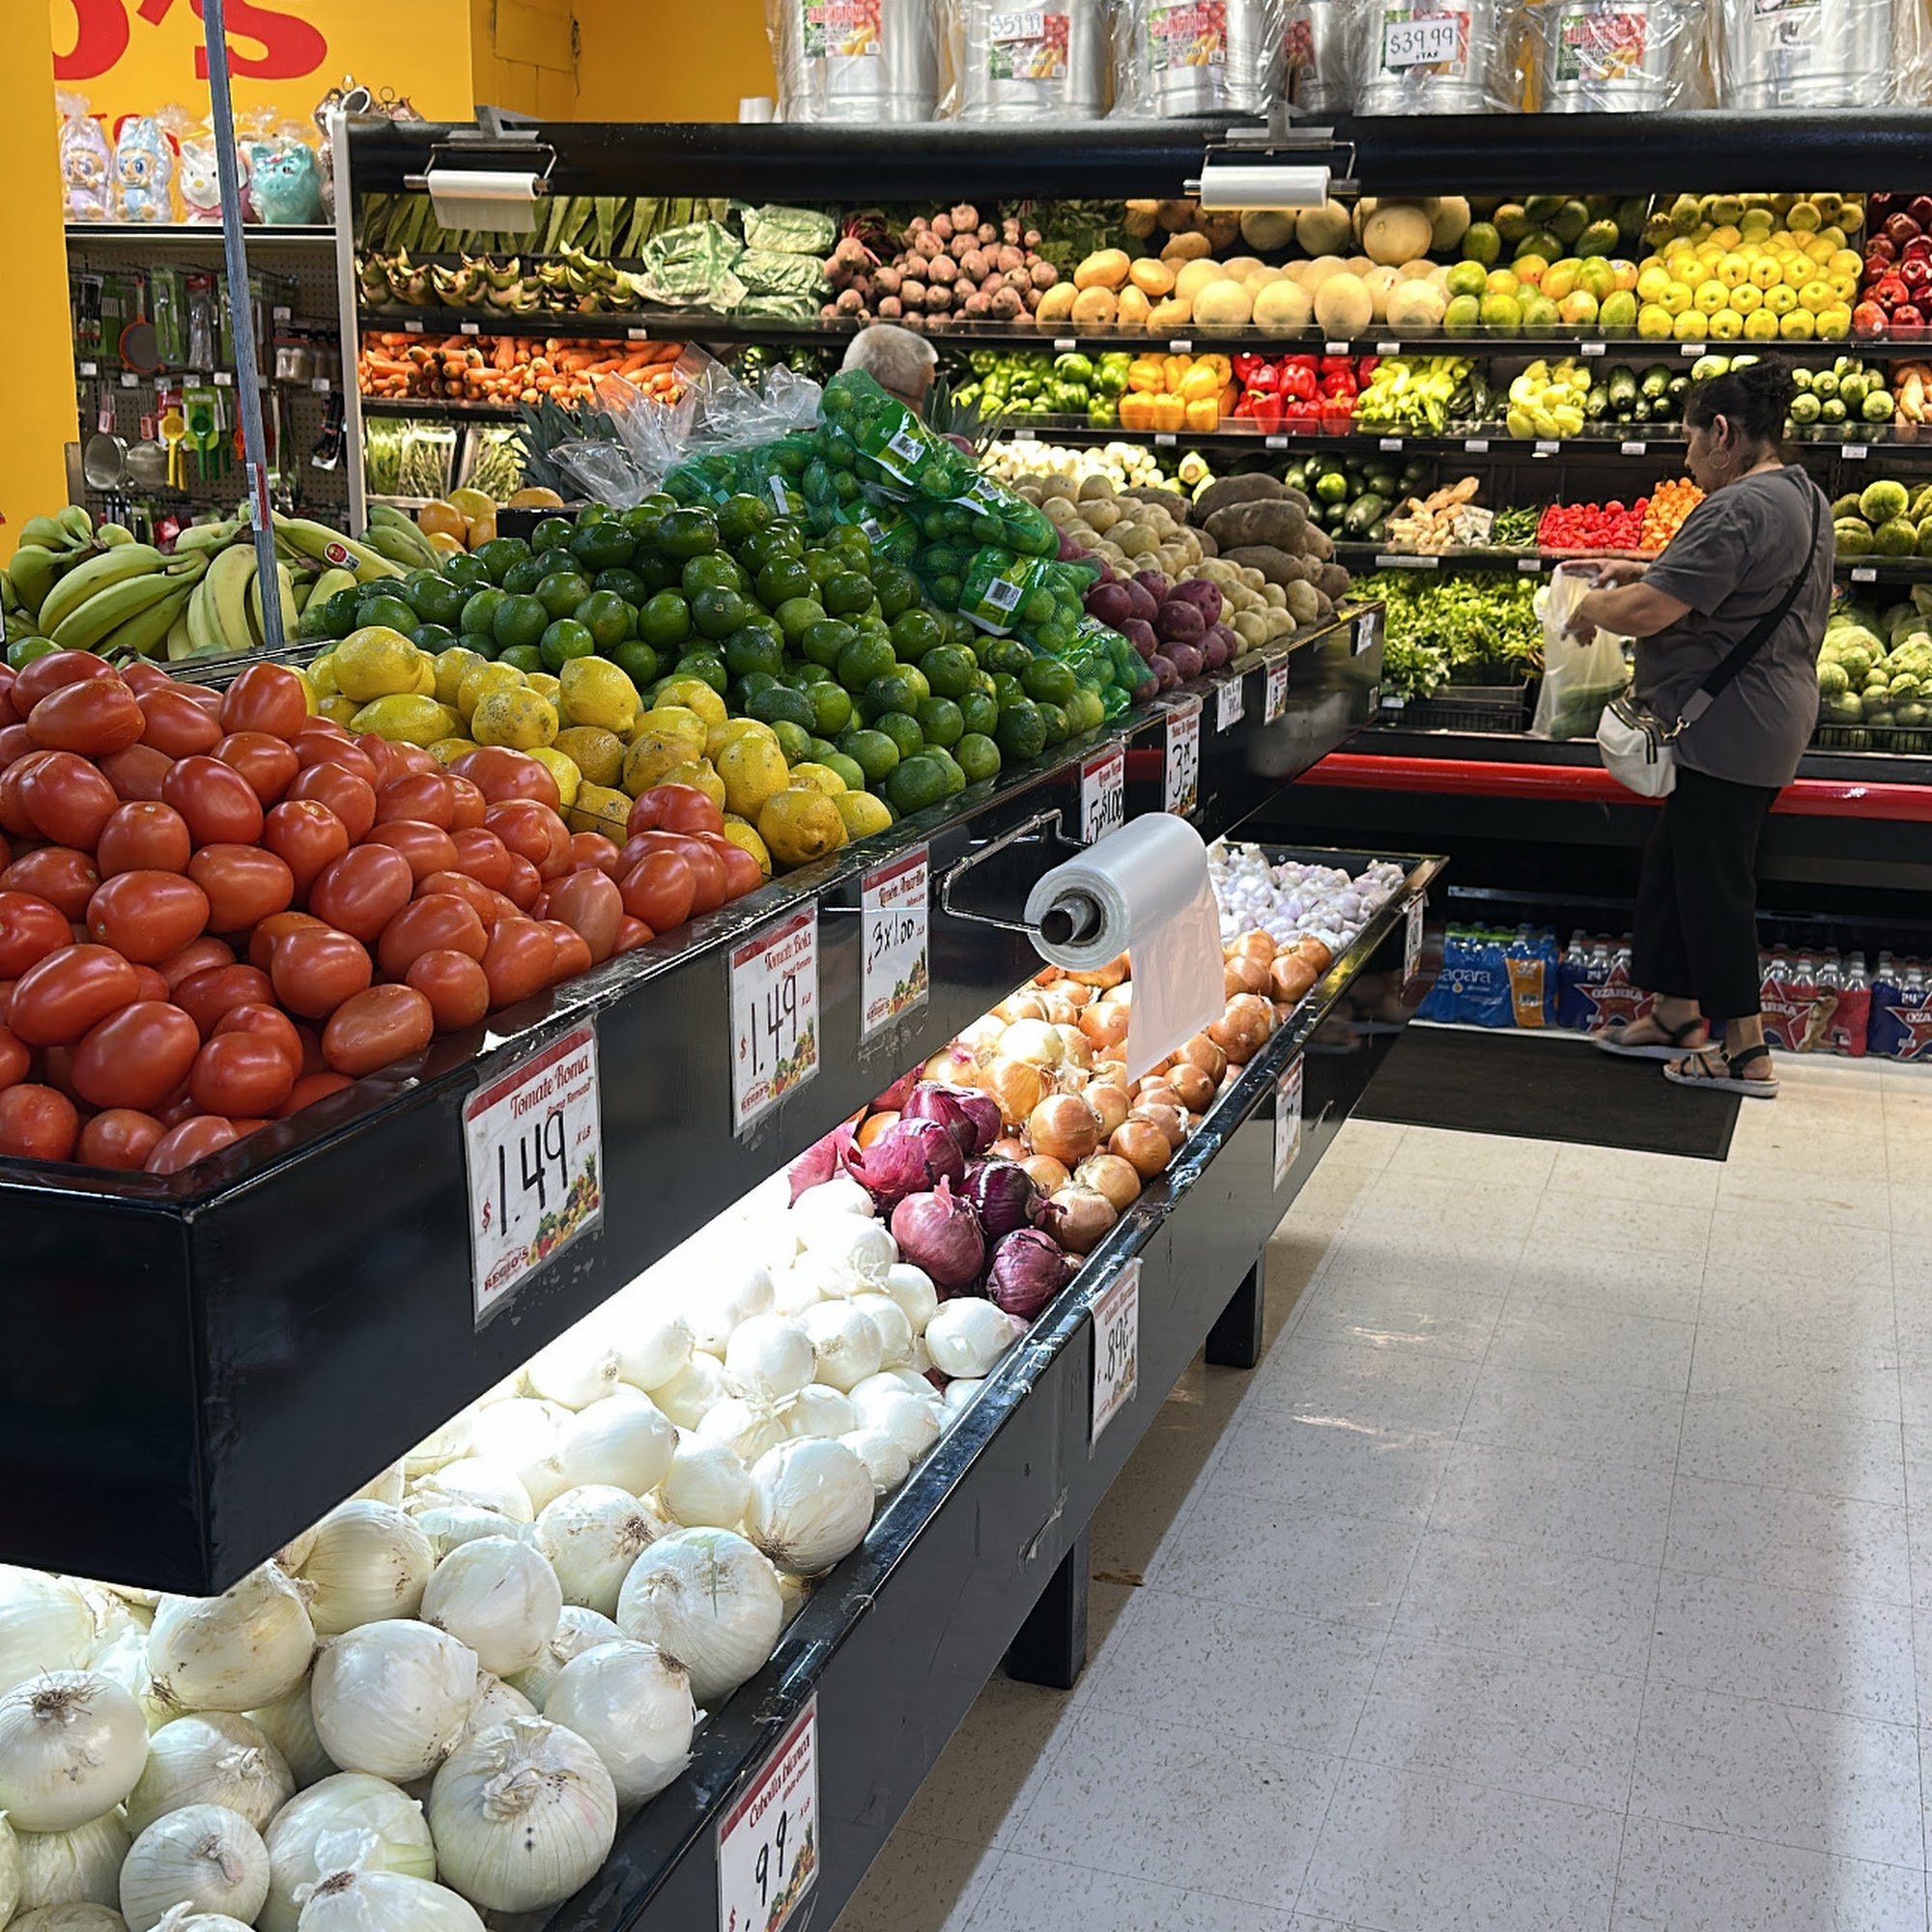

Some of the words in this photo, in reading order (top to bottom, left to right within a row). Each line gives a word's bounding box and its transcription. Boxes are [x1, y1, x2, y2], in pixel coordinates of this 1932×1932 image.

[1591, 987, 1644, 1002] OZARKA
[1761, 1001, 1798, 1016] ARKA
[1906, 1012, 1932, 1024] OZA
[510, 1077, 554, 1120] Tomate
[554, 1055, 589, 1090] Roma
[485, 1248, 529, 1292] REGIO'S
[750, 1776, 781, 1829] Cebolla
